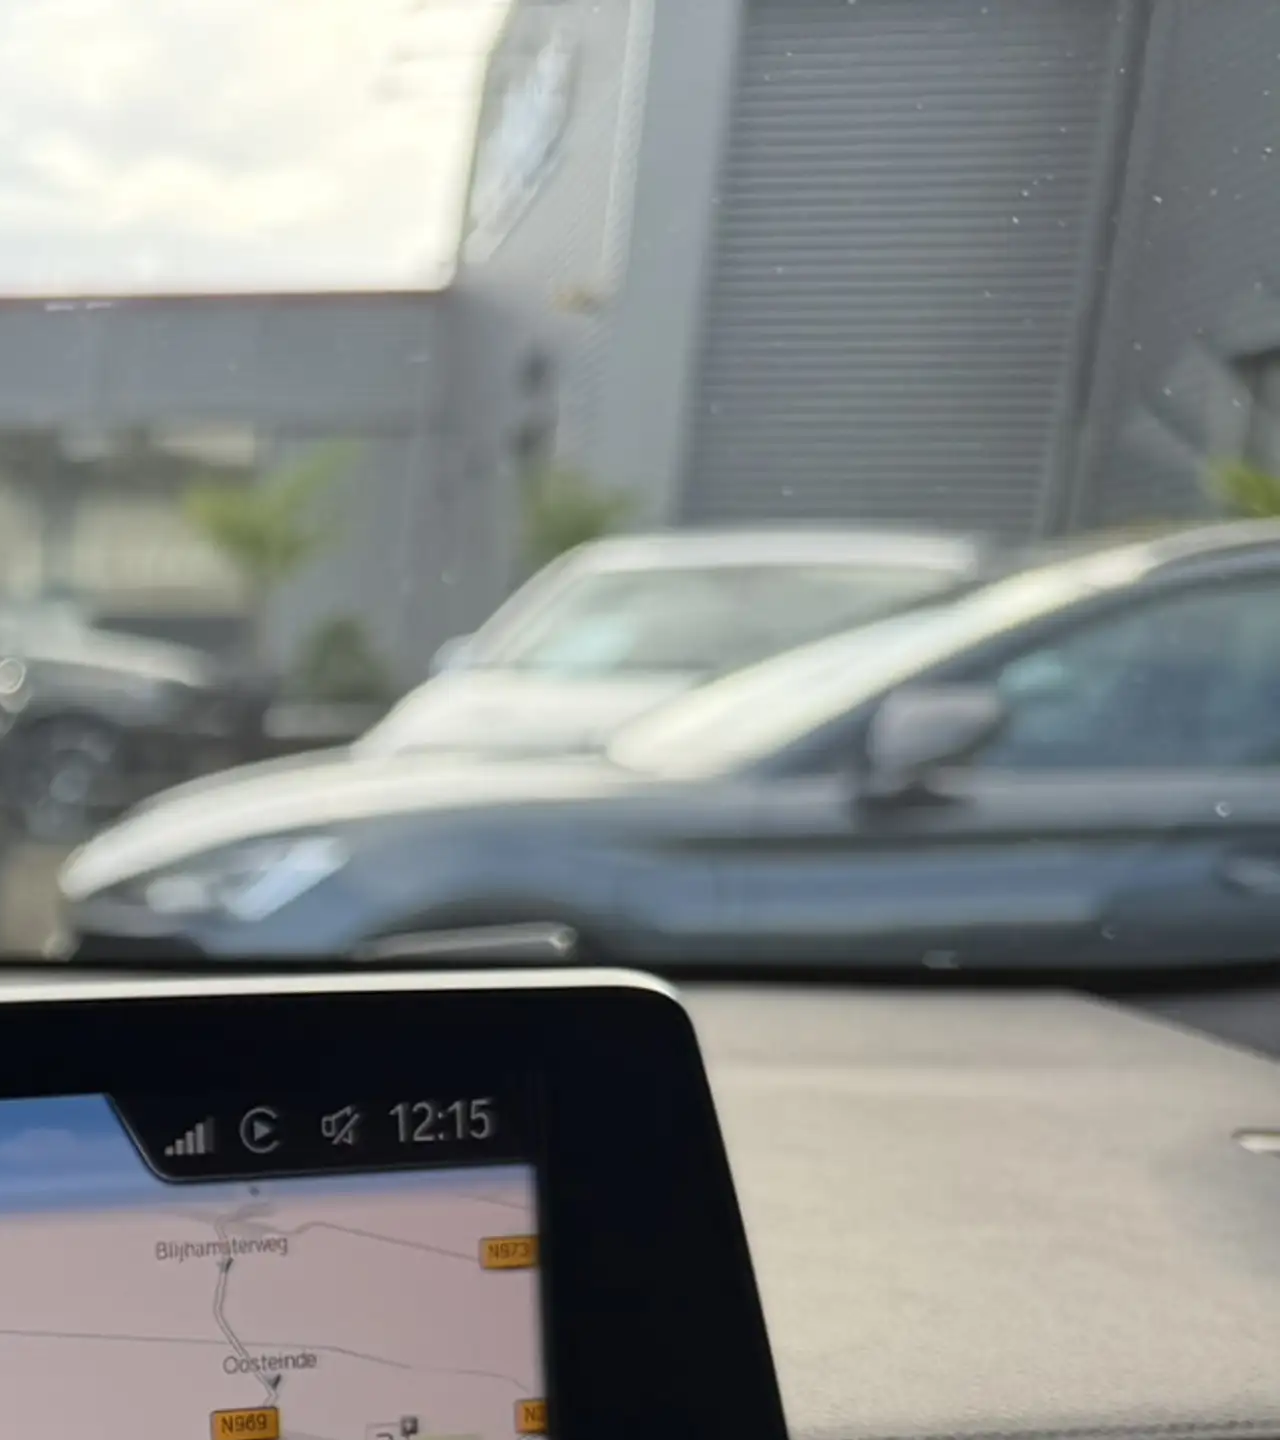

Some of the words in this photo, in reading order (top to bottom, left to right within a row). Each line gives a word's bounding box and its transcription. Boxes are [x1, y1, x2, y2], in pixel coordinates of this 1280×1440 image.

[388, 1098, 496, 1146] 12:15
[154, 1234, 290, 1262] Blijhamsterweg
[486, 1240, 532, 1262] N973
[222, 1350, 318, 1375] Oosteinde
[221, 1413, 269, 1436] N969
